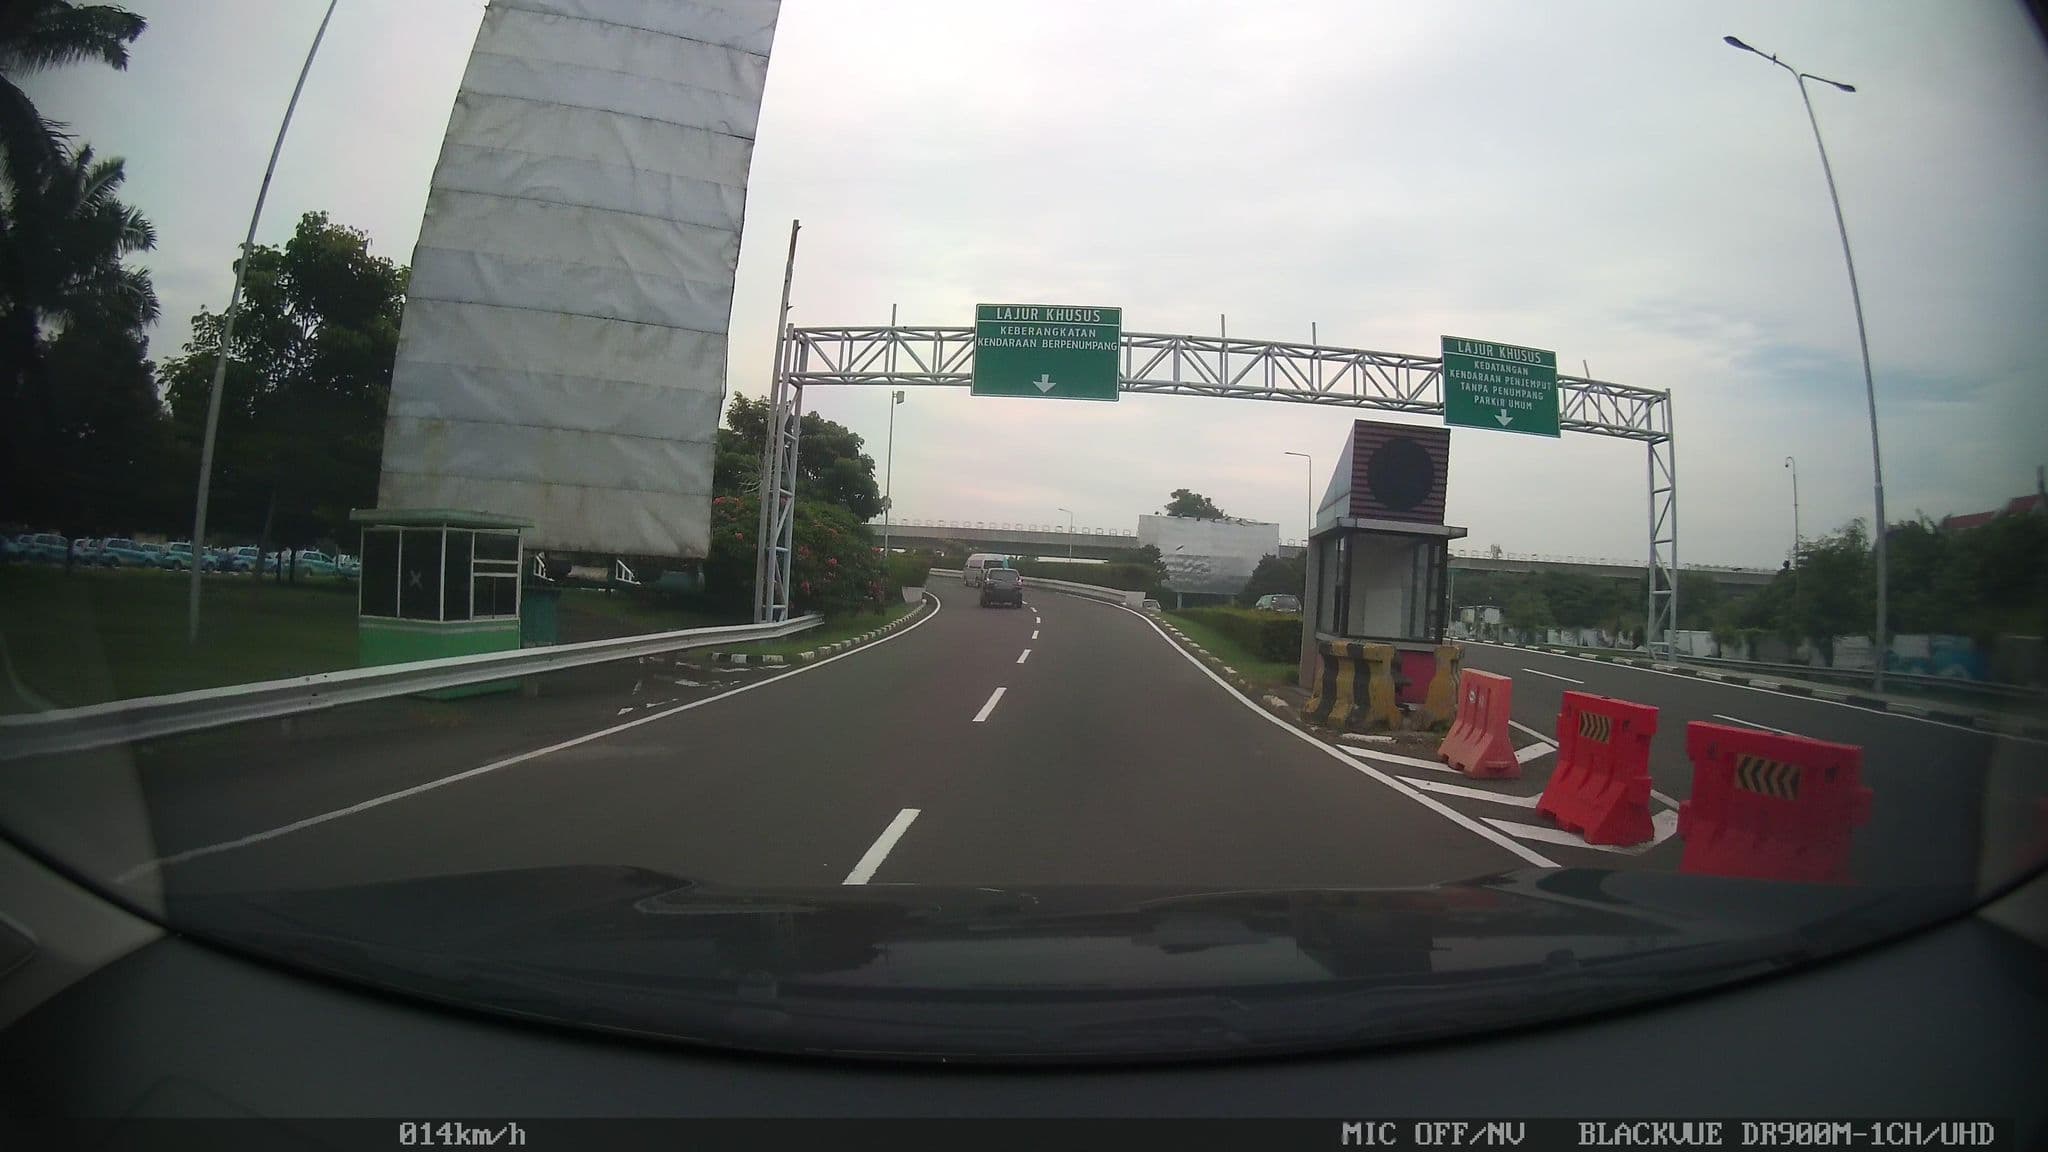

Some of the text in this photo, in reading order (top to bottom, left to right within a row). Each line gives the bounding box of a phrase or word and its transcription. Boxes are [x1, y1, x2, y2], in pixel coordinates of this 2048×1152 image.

[996, 307, 1101, 322] LAJUR KHUSUS
[1000, 326, 1096, 338] KEBERANGKATAN
[977, 337, 1117, 351] KENDARAAN BERPENUMPANG
[1457, 341, 1541, 364] LAJUR KHUSUS
[1474, 360, 1529, 376] KEDATANGAN
[1450, 369, 1501, 383] KENDARAAN
[1460, 381, 1544, 400] TANPA PENUMPANG
[1474, 395, 1533, 410] PARKIR UMUM
